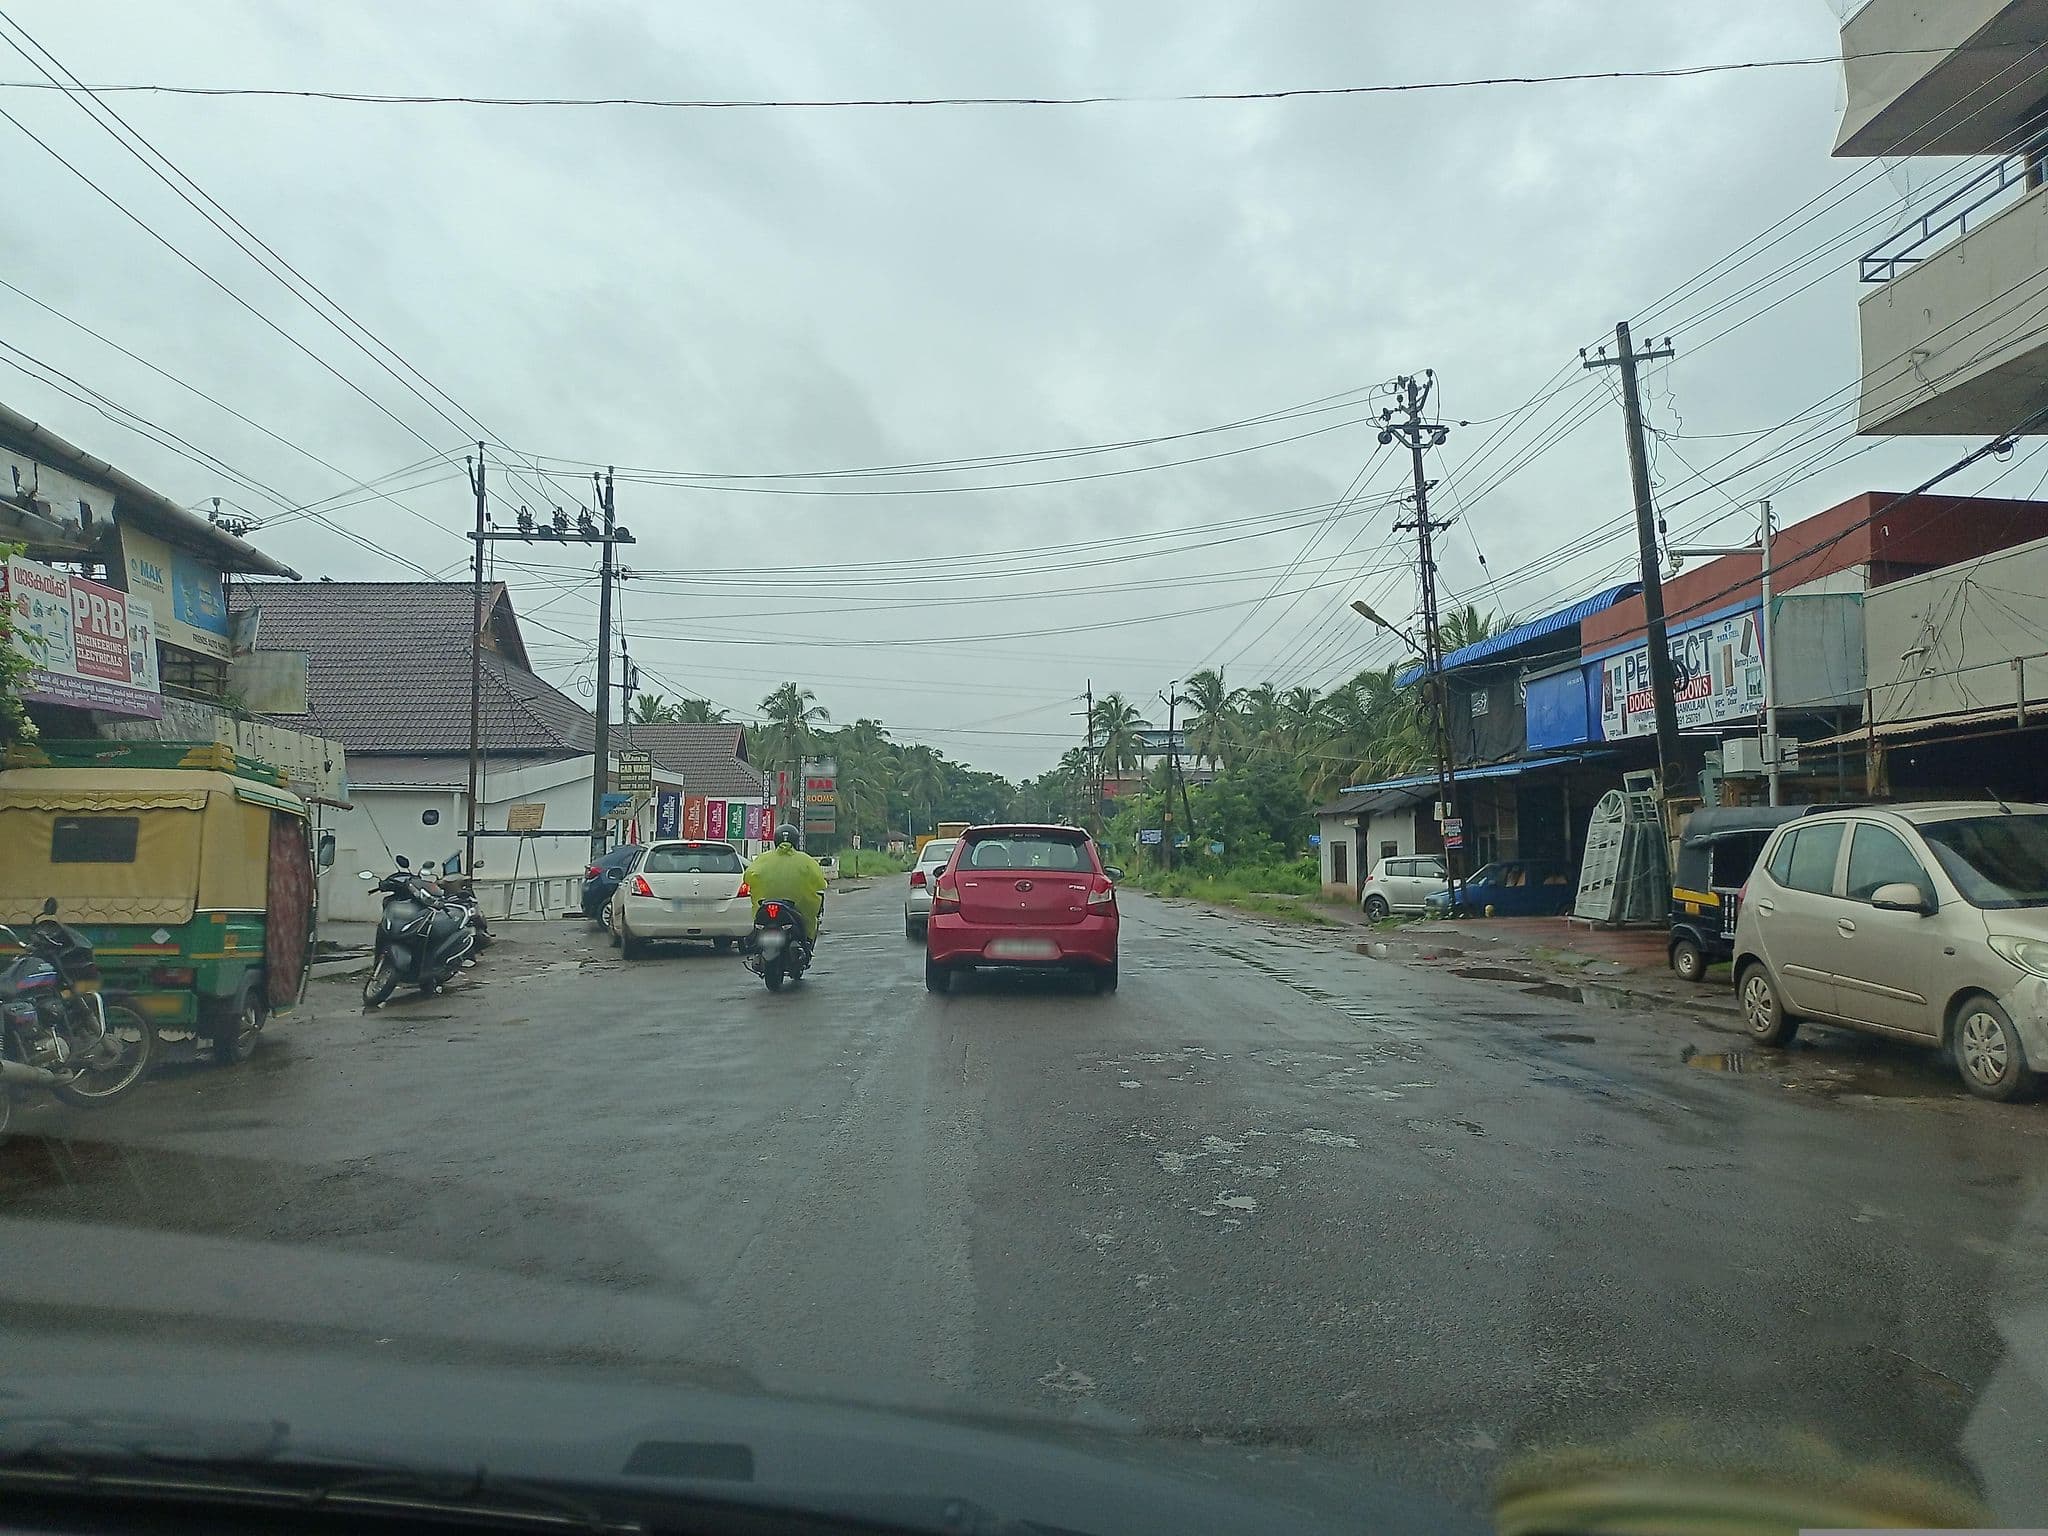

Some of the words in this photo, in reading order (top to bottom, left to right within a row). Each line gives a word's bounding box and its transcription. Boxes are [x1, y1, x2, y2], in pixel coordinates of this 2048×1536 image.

[140, 560, 163, 584] MAK
[72, 588, 126, 640] PRB
[75, 633, 121, 655] ENGINEERING
[77, 647, 123, 667] ELECTRICALS
[1625, 629, 1713, 692] PEECT
[807, 779, 833, 790] BAR
[806, 795, 834, 803] ROOMS
